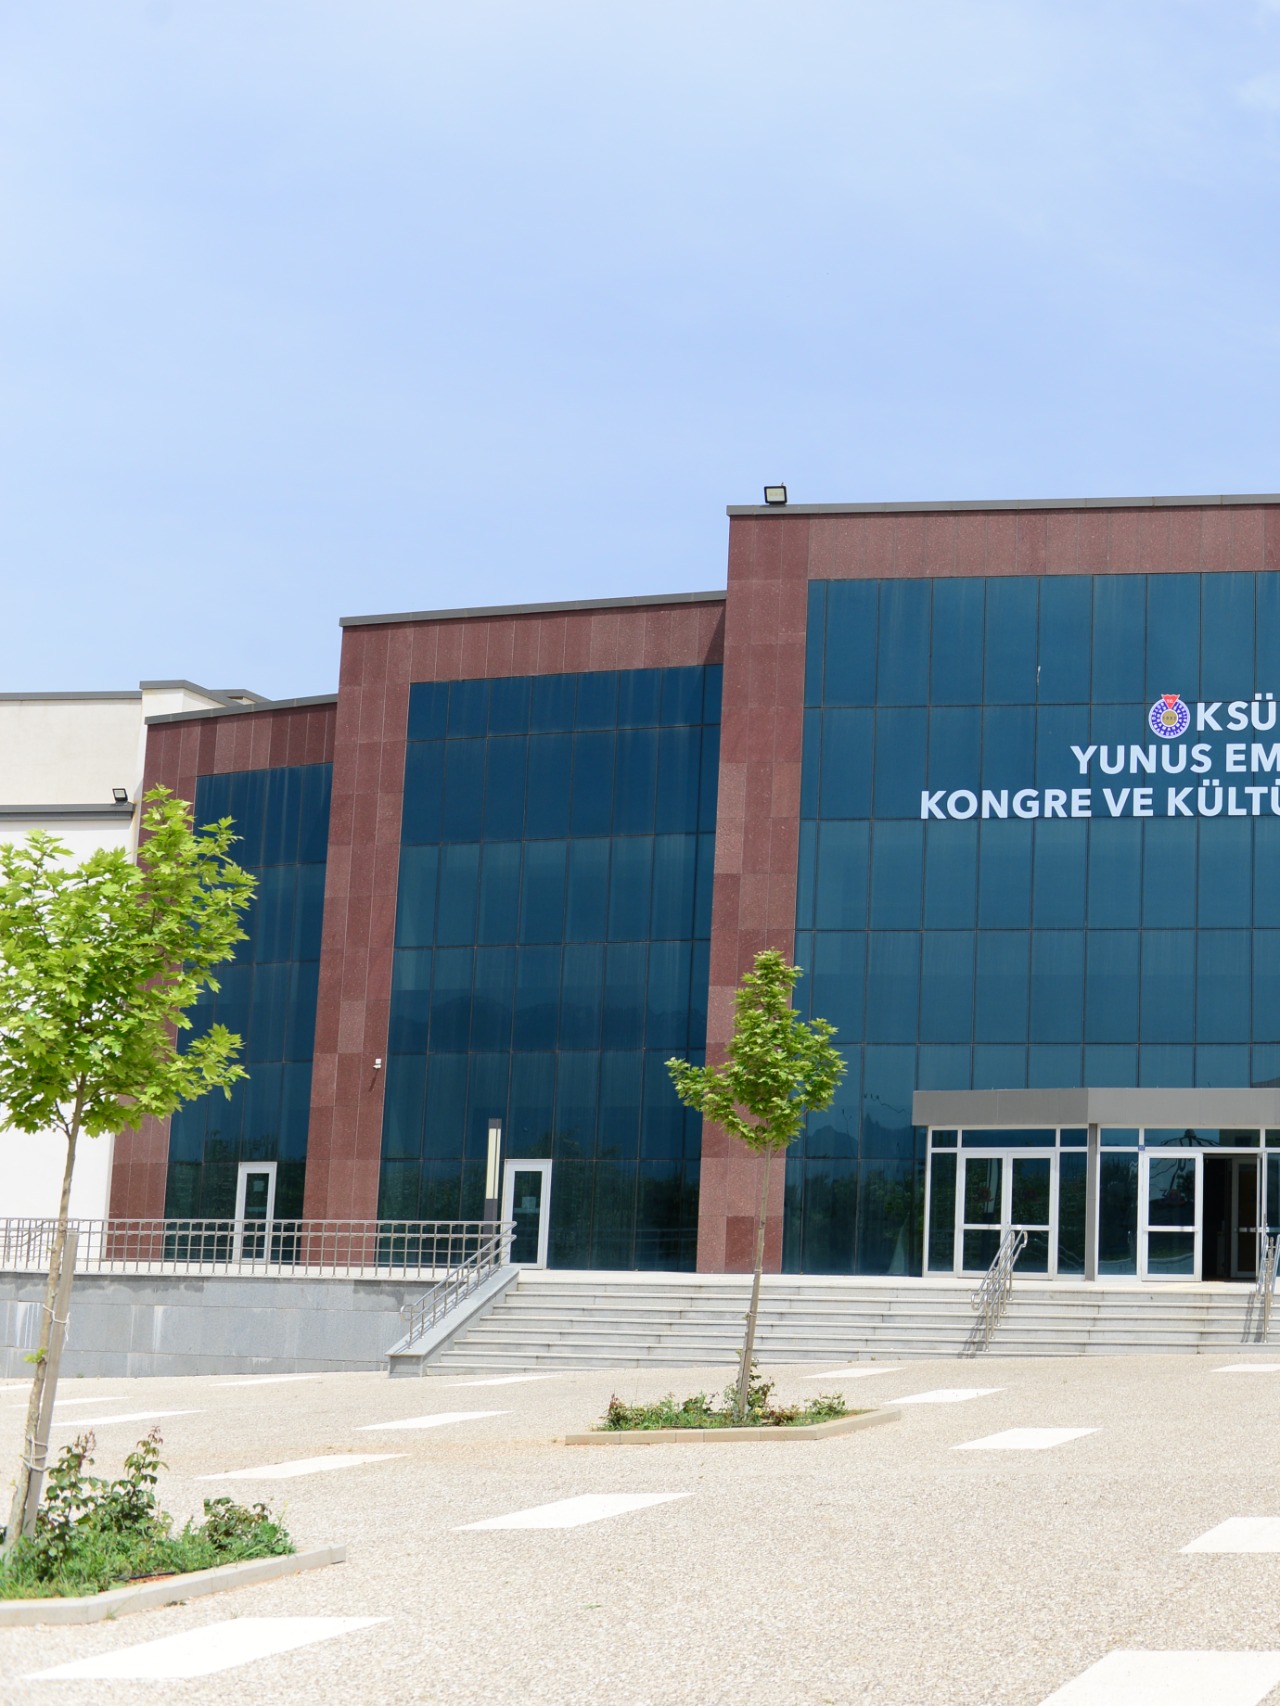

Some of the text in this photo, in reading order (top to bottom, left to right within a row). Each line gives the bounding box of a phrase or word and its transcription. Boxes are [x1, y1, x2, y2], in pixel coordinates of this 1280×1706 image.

[1196, 692, 1277, 732] KSÜ
[1070, 743, 1212, 775] YUNUS
[920, 788, 1092, 820] KONGRE
[1103, 787, 1154, 817] VE
